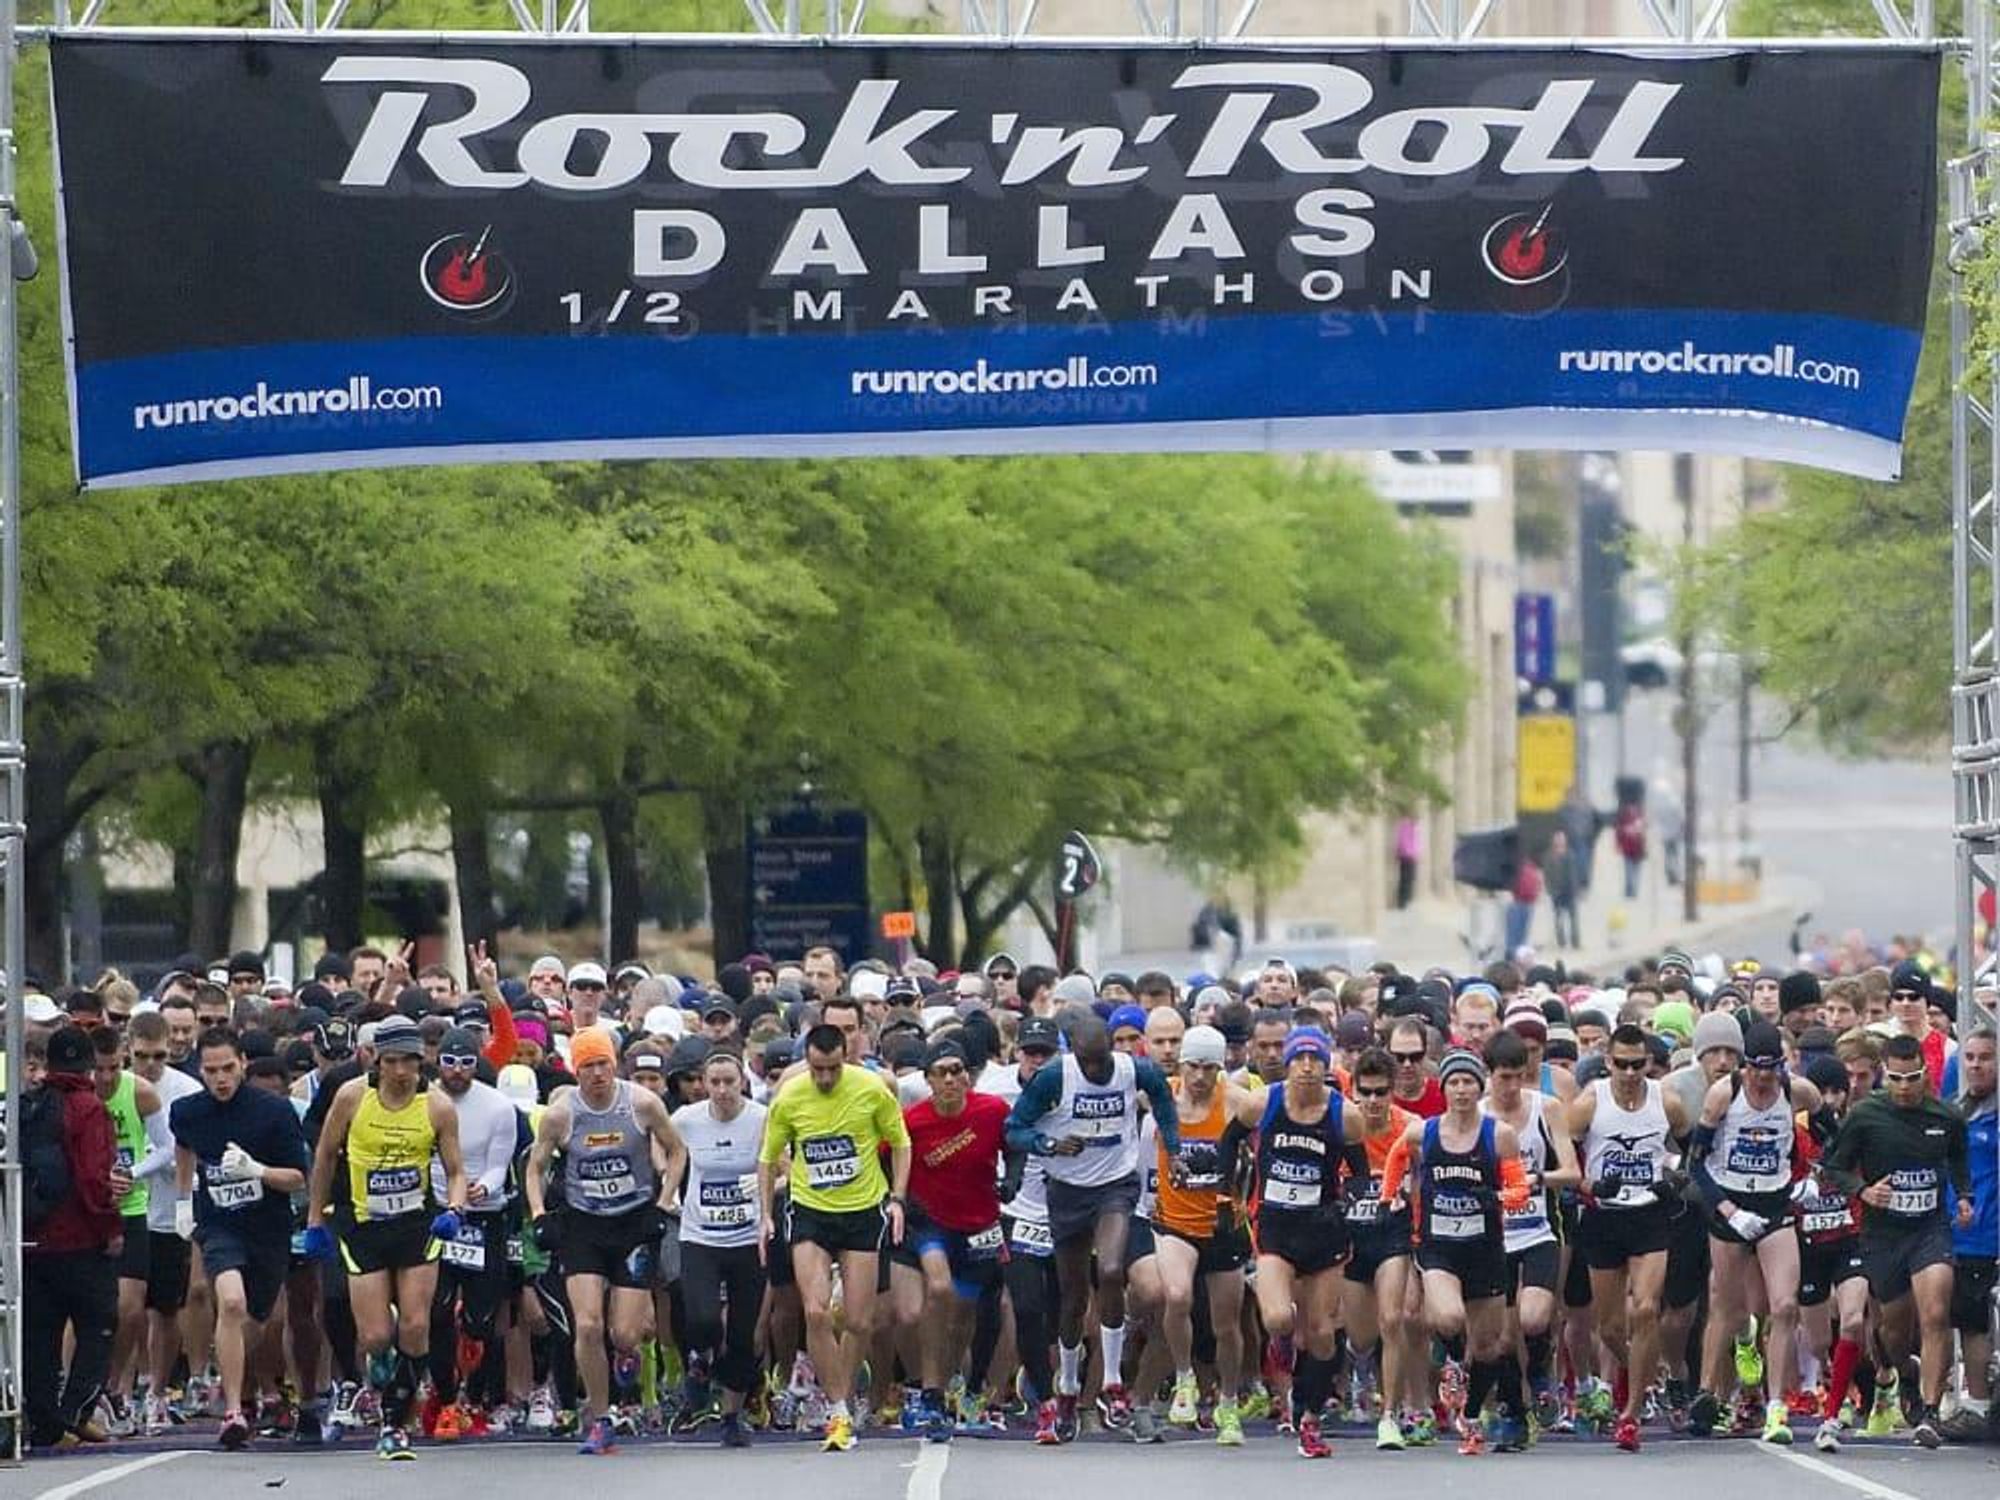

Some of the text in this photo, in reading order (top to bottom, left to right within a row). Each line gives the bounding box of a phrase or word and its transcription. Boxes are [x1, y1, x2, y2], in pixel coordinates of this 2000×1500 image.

[320, 56, 973, 189] Rock
[1171, 62, 1685, 176] Roll
[632, 188, 1377, 277] DALLAS
[559, 268, 1432, 324] 1/2 MARATHON
[851, 356, 1158, 394] runrocknroll.com
[1559, 340, 1860, 390] runrocknroll.com
[134, 376, 442, 430] runrocknroll.com
[1061, 856, 1078, 893] 2
[815, 1162, 855, 1179] 1445
[1730, 1154, 1778, 1169] DALLAS
[215, 1183, 256, 1204] 1704
[599, 1181, 619, 1195] 10
[1287, 1187, 1299, 1202] 5
[1746, 1177, 1756, 1191] 4
[387, 1198, 404, 1212] 11
[1453, 1219, 1463, 1233] 7
